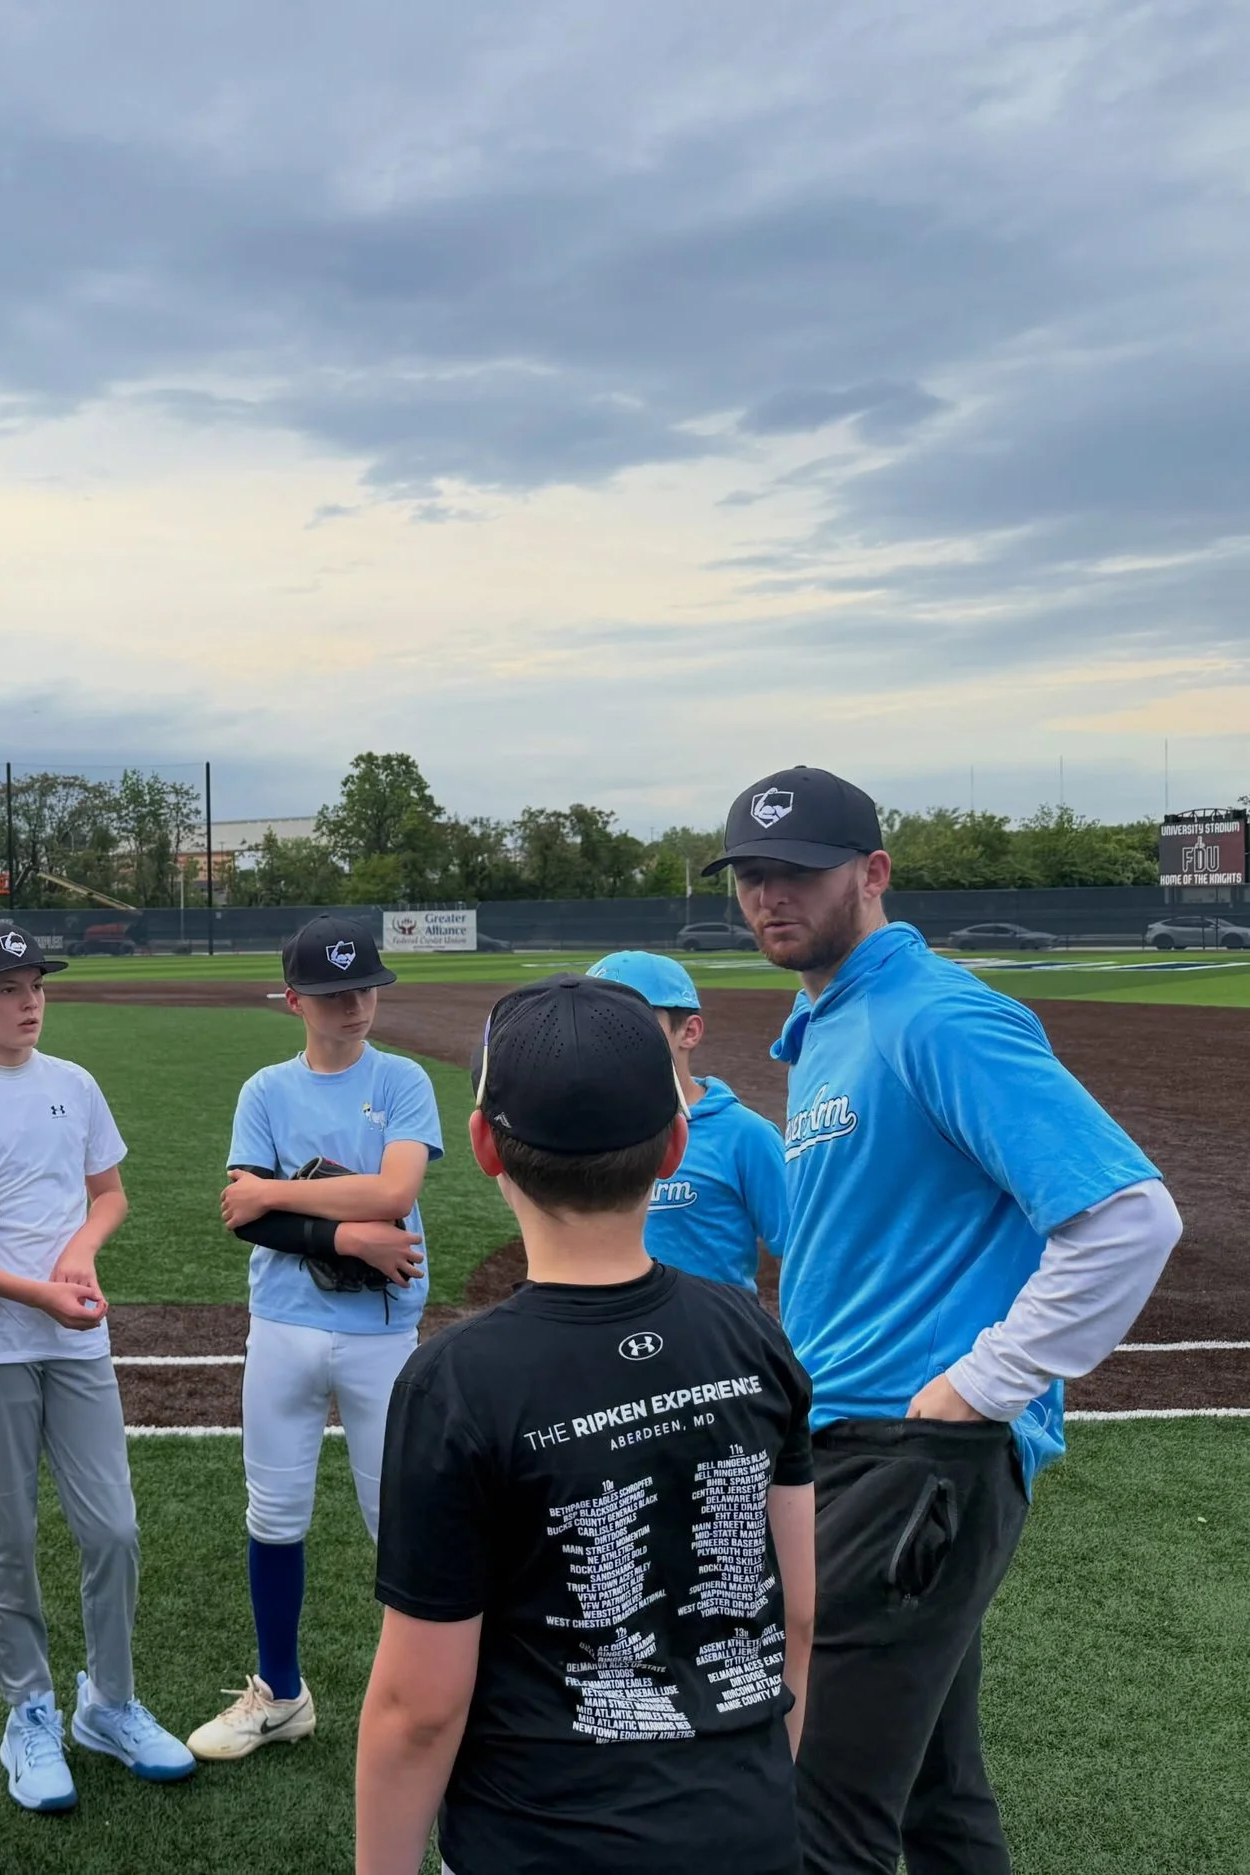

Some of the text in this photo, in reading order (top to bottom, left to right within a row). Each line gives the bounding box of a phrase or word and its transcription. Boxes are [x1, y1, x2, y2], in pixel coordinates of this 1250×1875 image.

[1161, 822, 1240, 836] UNIVERSITY STADIUM
[1182, 846, 1220, 873] FDU
[1160, 873, 1242, 886] HOME OF THE KNIGHTS
[425, 913, 466, 923] Greater
[425, 925, 467, 936] Alliance
[524, 1375, 763, 1451] THE RIPKEN EXPERIENCE
[610, 1412, 715, 1451] ABERDEEN, MD
[697, 1461, 716, 1472] BELL
[717, 1456, 750, 1468] RINGERS
[694, 1466, 748, 1482] BELL RINGERS
[706, 1478, 728, 1487] BHBL
[730, 1471, 765, 1486] SPARTANS
[692, 1484, 756, 1500] CENTRAL JERSEY
[706, 1494, 750, 1504] DELAWARE
[549, 1500, 592, 1516] BETHPAGE
[592, 1492, 618, 1508] EAGLES
[563, 1490, 646, 1522] BSP BLACKSOX SHEPARD
[701, 1504, 739, 1514] DENVILLE
[546, 1494, 658, 1536] BUCKS COUNTY GENERALS BLACK
[715, 1511, 764, 1520] EHT EAGLES
[578, 1512, 637, 1537] CARLISLE ROYALS
[692, 1520, 744, 1533] MAIN STREET
[562, 1524, 650, 1556] MAIN STREET MOMENTUM
[594, 1526, 628, 1546] DIRTDOGS
[694, 1529, 738, 1540] MID-STATE
[691, 1538, 730, 1550] PIONEERS
[697, 1546, 740, 1557] PLYMOUTH
[570, 1546, 648, 1574] ROCKLAND ELITE GOLD
[588, 1542, 635, 1564] NE ATHLETICS
[716, 1555, 762, 1566] PRO SKILLS
[566, 1561, 651, 1592] TRIPLETOWN ACES RILEY
[590, 1560, 635, 1582] SANDSHARKS
[698, 1563, 763, 1574] ROCKLAND ELITE
[722, 1572, 760, 1583] SJ BEAST
[578, 1574, 645, 1602] VFW PATRIOTS BLUE
[688, 1580, 727, 1595] SOUTHERN
[700, 1589, 754, 1601] WAPPINGERS
[580, 1582, 644, 1610] VFW PATRIOTS RED
[546, 1589, 666, 1628] WEST CHESTER DRAGONS NATIONAL
[582, 1592, 642, 1620] WEBSTER WOLVES
[678, 1598, 730, 1616] WEST CHESTER
[700, 1606, 744, 1618] YORKTOWN
[610, 1632, 642, 1652] OUTLAWS
[696, 1630, 786, 1666] BASEBALL WHITE
[699, 1640, 726, 1655] ASCENT
[630, 1662, 666, 1673] UPSTATE
[707, 1652, 784, 1683] DELMARVA ACES EAST
[724, 1658, 734, 1668] CT
[598, 1669, 634, 1680] DIRTDOGS
[730, 1669, 767, 1688] DIRTDOGS
[625, 1688, 660, 1698] BASEBALL
[660, 1684, 680, 1696] LOSE
[626, 1678, 652, 1688] EAGLES
[584, 1697, 606, 1708] MAIN
[608, 1699, 634, 1710] STREET
[716, 1698, 743, 1712] ORANGE
[742, 1689, 770, 1706] COUNTY
[576, 1704, 592, 1716] MID
[594, 1708, 633, 1720] ATLANTIC
[578, 1714, 594, 1724] MID
[597, 1718, 636, 1730] ATLANTIC
[572, 1721, 696, 1740] NEWTOWN EDGMONT ATHLETICS
